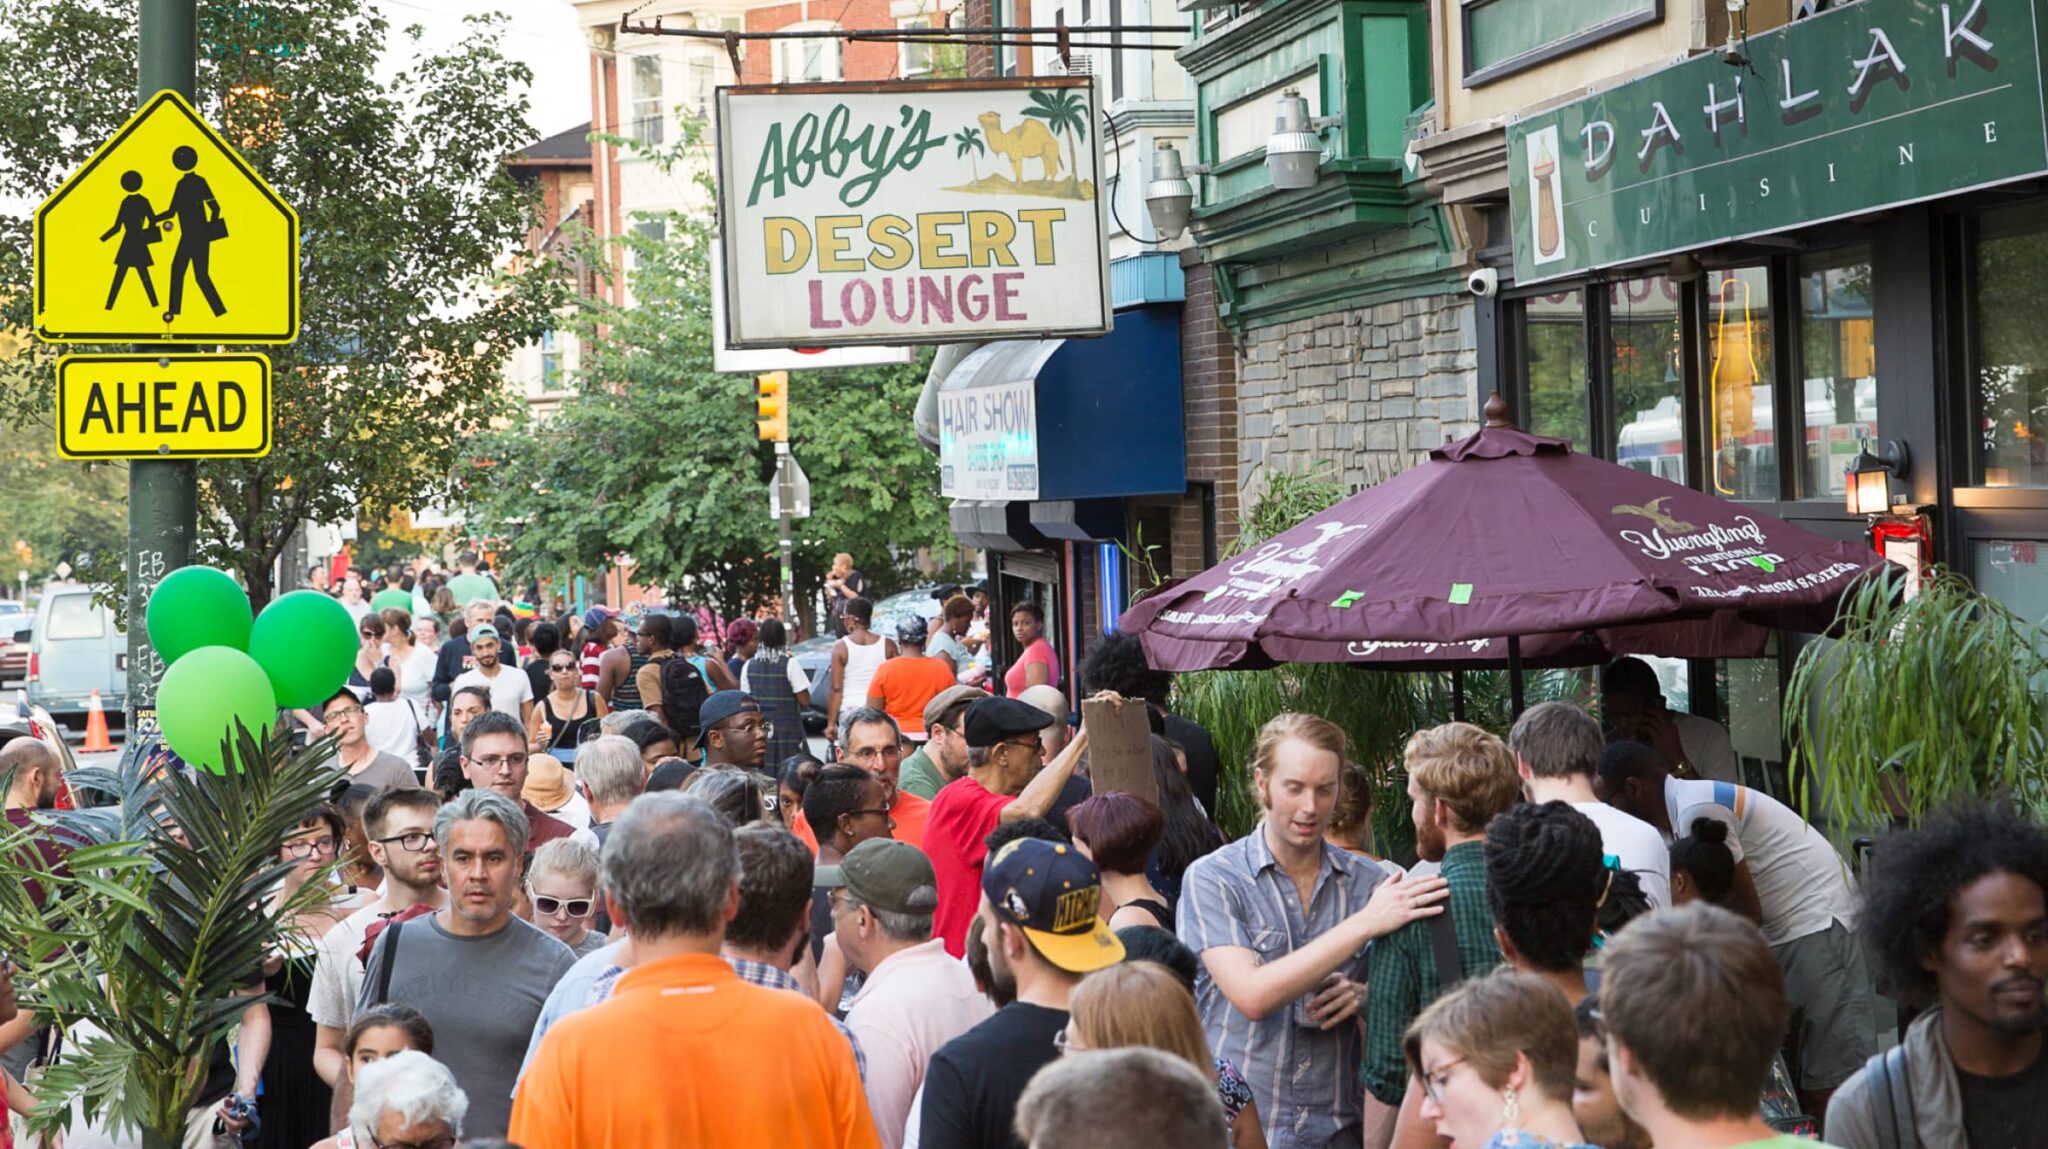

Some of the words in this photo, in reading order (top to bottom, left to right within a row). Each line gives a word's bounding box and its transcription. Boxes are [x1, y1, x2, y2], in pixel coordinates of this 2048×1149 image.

[1579, 0, 1994, 169] DAHLAK
[746, 103, 948, 208] Abby's
[1588, 121, 1997, 238] CUISINE
[763, 208, 1066, 275] DESERT
[808, 272, 1028, 329] LOUNGE
[80, 381, 247, 434] AHEAD
[942, 396, 978, 439] HAIR
[983, 389, 1030, 440] SHOW
[138, 550, 166, 578] EB
[1620, 515, 1767, 560] Yuengling
